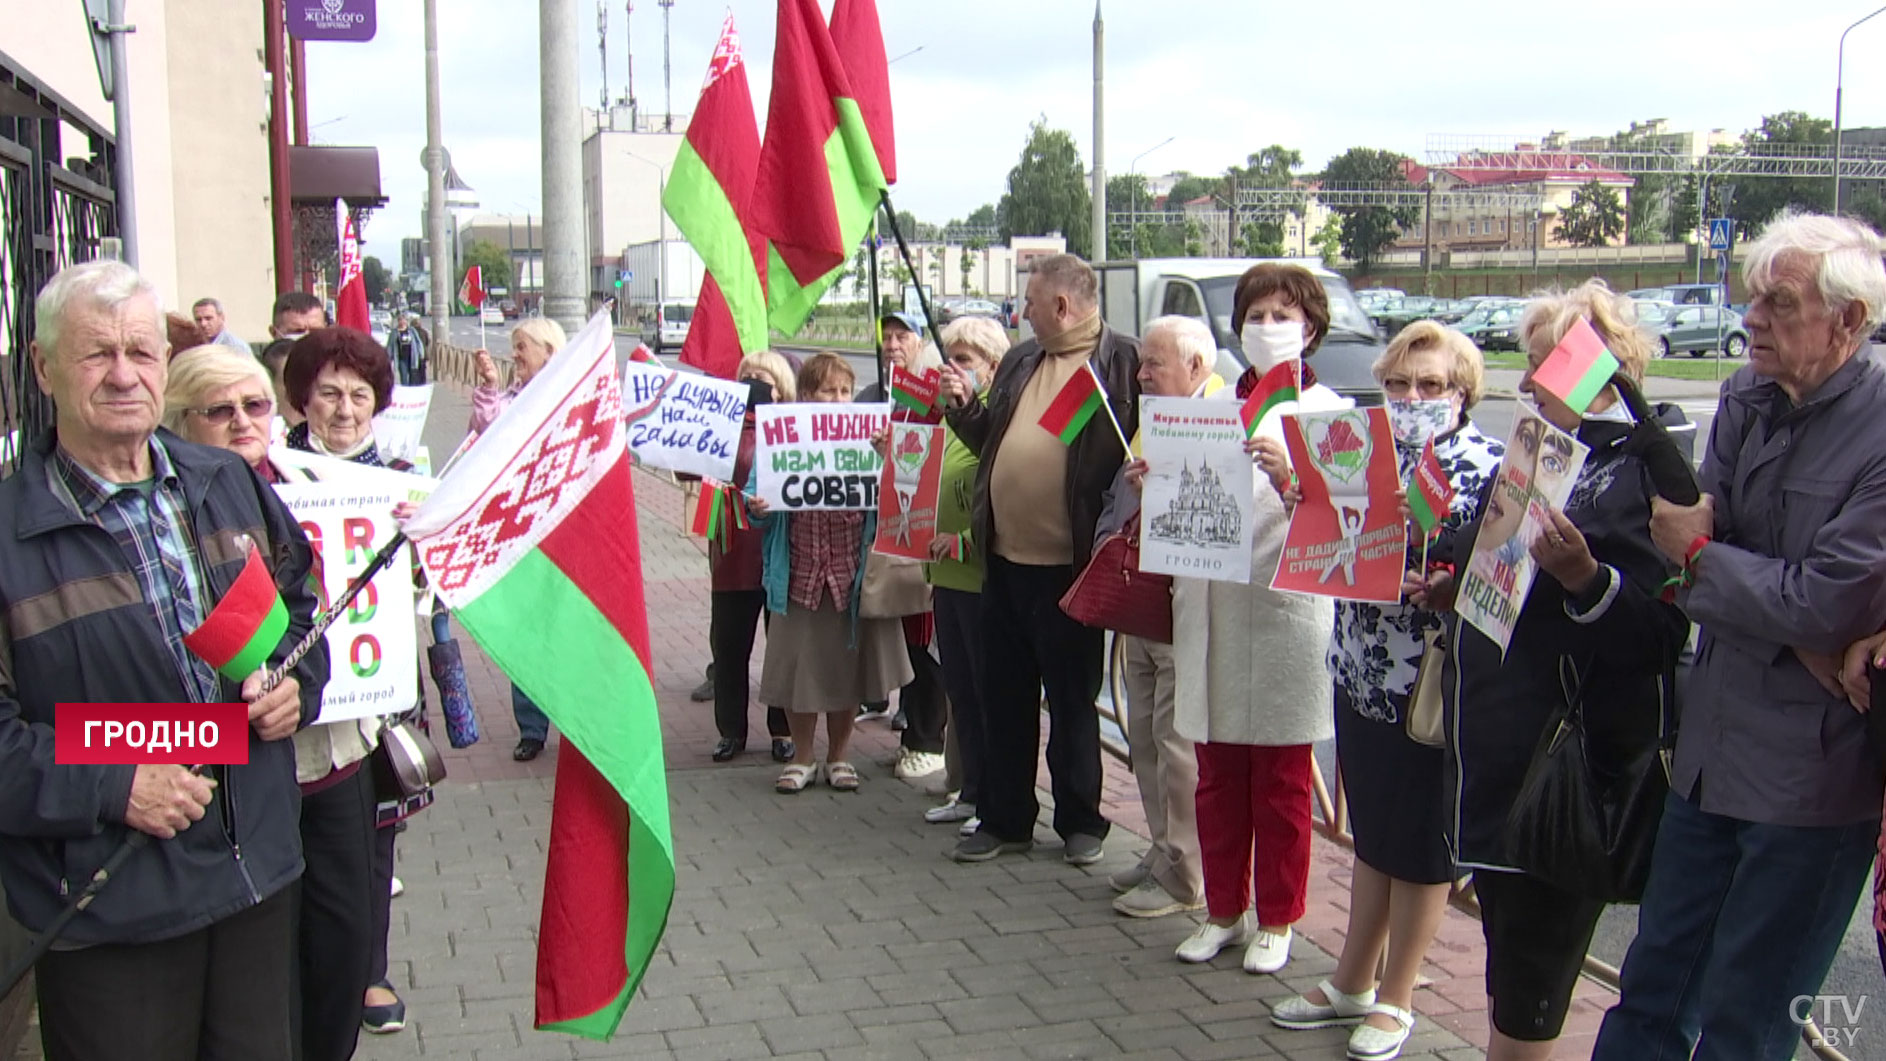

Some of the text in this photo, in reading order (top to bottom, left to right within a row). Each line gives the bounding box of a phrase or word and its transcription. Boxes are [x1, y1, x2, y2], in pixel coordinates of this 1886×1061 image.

[304, 12, 365, 23] ЖЕНСКОГО
[1153, 413, 1237, 426] Мира и счастья
[762, 416, 799, 446] НЕ
[1151, 427, 1241, 443] Любимому городу
[340, 495, 390, 509] страна
[1286, 546, 1300, 560] НЕ
[1354, 523, 1402, 546] ПОРВАТЬ
[1165, 554, 1222, 570] ГРОДНО
[1493, 559, 1517, 599] МЫ
[359, 685, 394, 702] город
